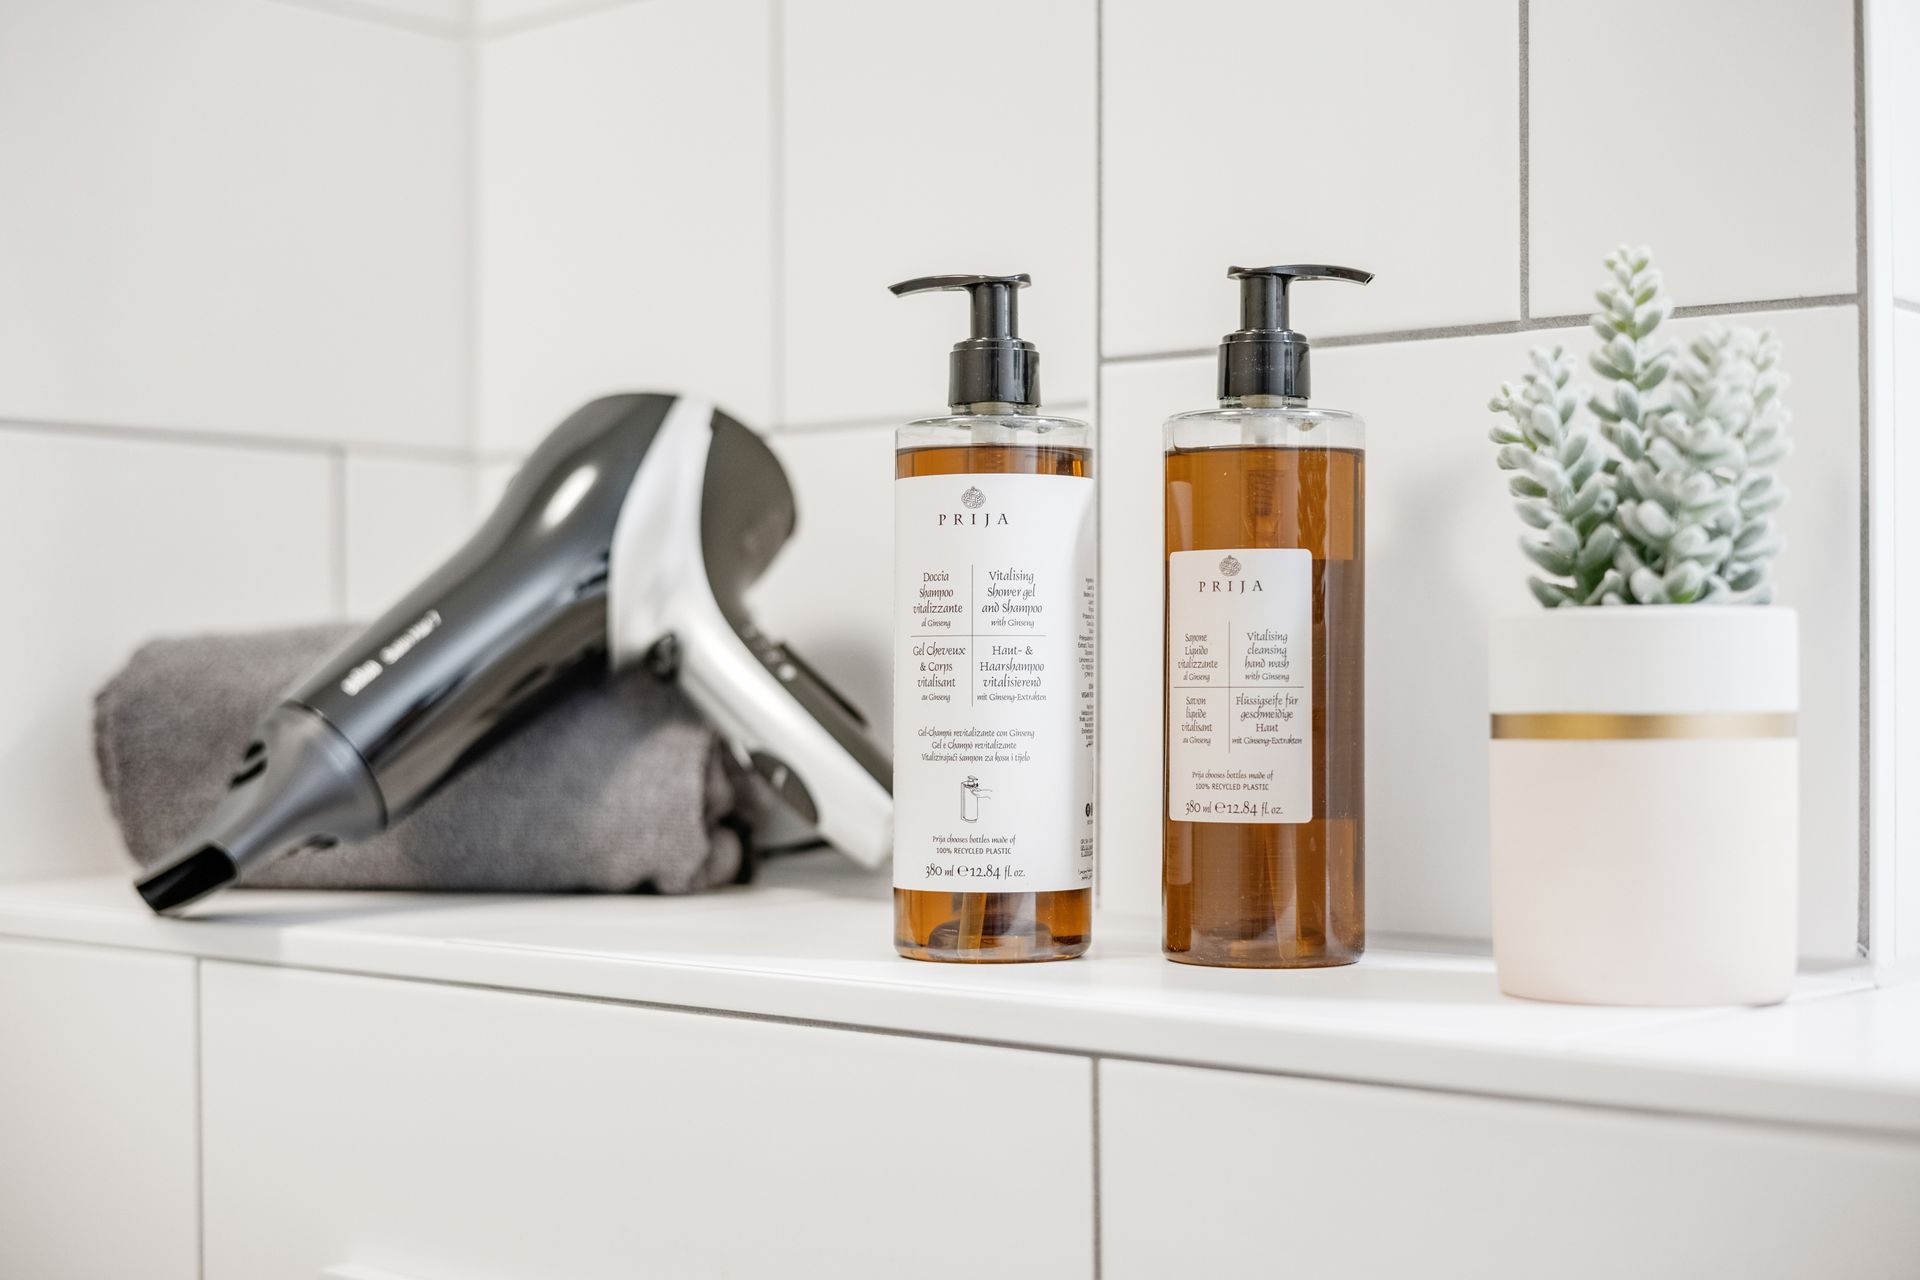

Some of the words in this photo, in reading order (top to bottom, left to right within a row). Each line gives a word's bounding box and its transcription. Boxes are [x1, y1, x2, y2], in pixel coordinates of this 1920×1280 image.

[938, 513, 1008, 528] PRIJA
[923, 571, 949, 582] Doccia
[989, 567, 1034, 584] Vitalising
[919, 584, 953, 600] Shampoo
[988, 583, 1021, 597] Shower
[1023, 583, 1035, 600] gel
[1199, 580, 1263, 594] PRIJA
[913, 600, 963, 614] vitalizzante
[982, 602, 999, 613] and
[1002, 599, 1042, 615] Shampoo
[928, 619, 951, 628] Ginseng
[991, 617, 1006, 627] with
[1008, 619, 1034, 628] Ginseng
[1185, 633, 1207, 644] Sapone
[1247, 629, 1288, 643] Vitalising
[913, 642, 924, 656] Gel
[926, 642, 966, 657] Cheveux
[992, 645, 1022, 655] Haut-
[1025, 646, 1033, 655] &
[1185, 646, 1208, 658] Liquido
[1248, 642, 1287, 658] cleansing
[920, 662, 926, 671] &
[928, 662, 952, 674] Corps
[980, 657, 1044, 674] Haarshampoo
[1178, 656, 1218, 668] vitalizzante
[1245, 656, 1265, 671] hand
[1268, 657, 1289, 669] wash
[917, 674, 956, 688] vitalisant
[983, 674, 1041, 688] vitalisierend
[1245, 672, 1260, 680] with
[1262, 673, 1290, 681] Ginseng
[929, 694, 950, 703] Ginseng
[1186, 696, 1206, 705] Savon
[1236, 693, 1282, 709] Flüssigseife
[1286, 692, 1298, 708] für
[1186, 706, 1206, 720] liquide
[1240, 706, 1293, 722] geschmeidige
[954, 726, 994, 737] revitalizante
[1009, 729, 1035, 738] Ginseng
[1182, 720, 1212, 732] vitalisant
[1256, 724, 1278, 732] Haut
[932, 740, 941, 749] Gel
[975, 740, 1016, 749] revitalizante
[1226, 770, 1247, 779] bottles
[1267, 770, 1274, 781] of
[1185, 800, 1201, 815] 380
[1203, 802, 1212, 813] ml
[932, 835, 945, 843] Prija
[947, 834, 968, 844] chooses
[969, 835, 990, 843] bottles
[1010, 834, 1015, 845] of
[925, 863, 942, 878] 380
[945, 865, 953, 877] ml
[1014, 869, 1025, 877] oz.
